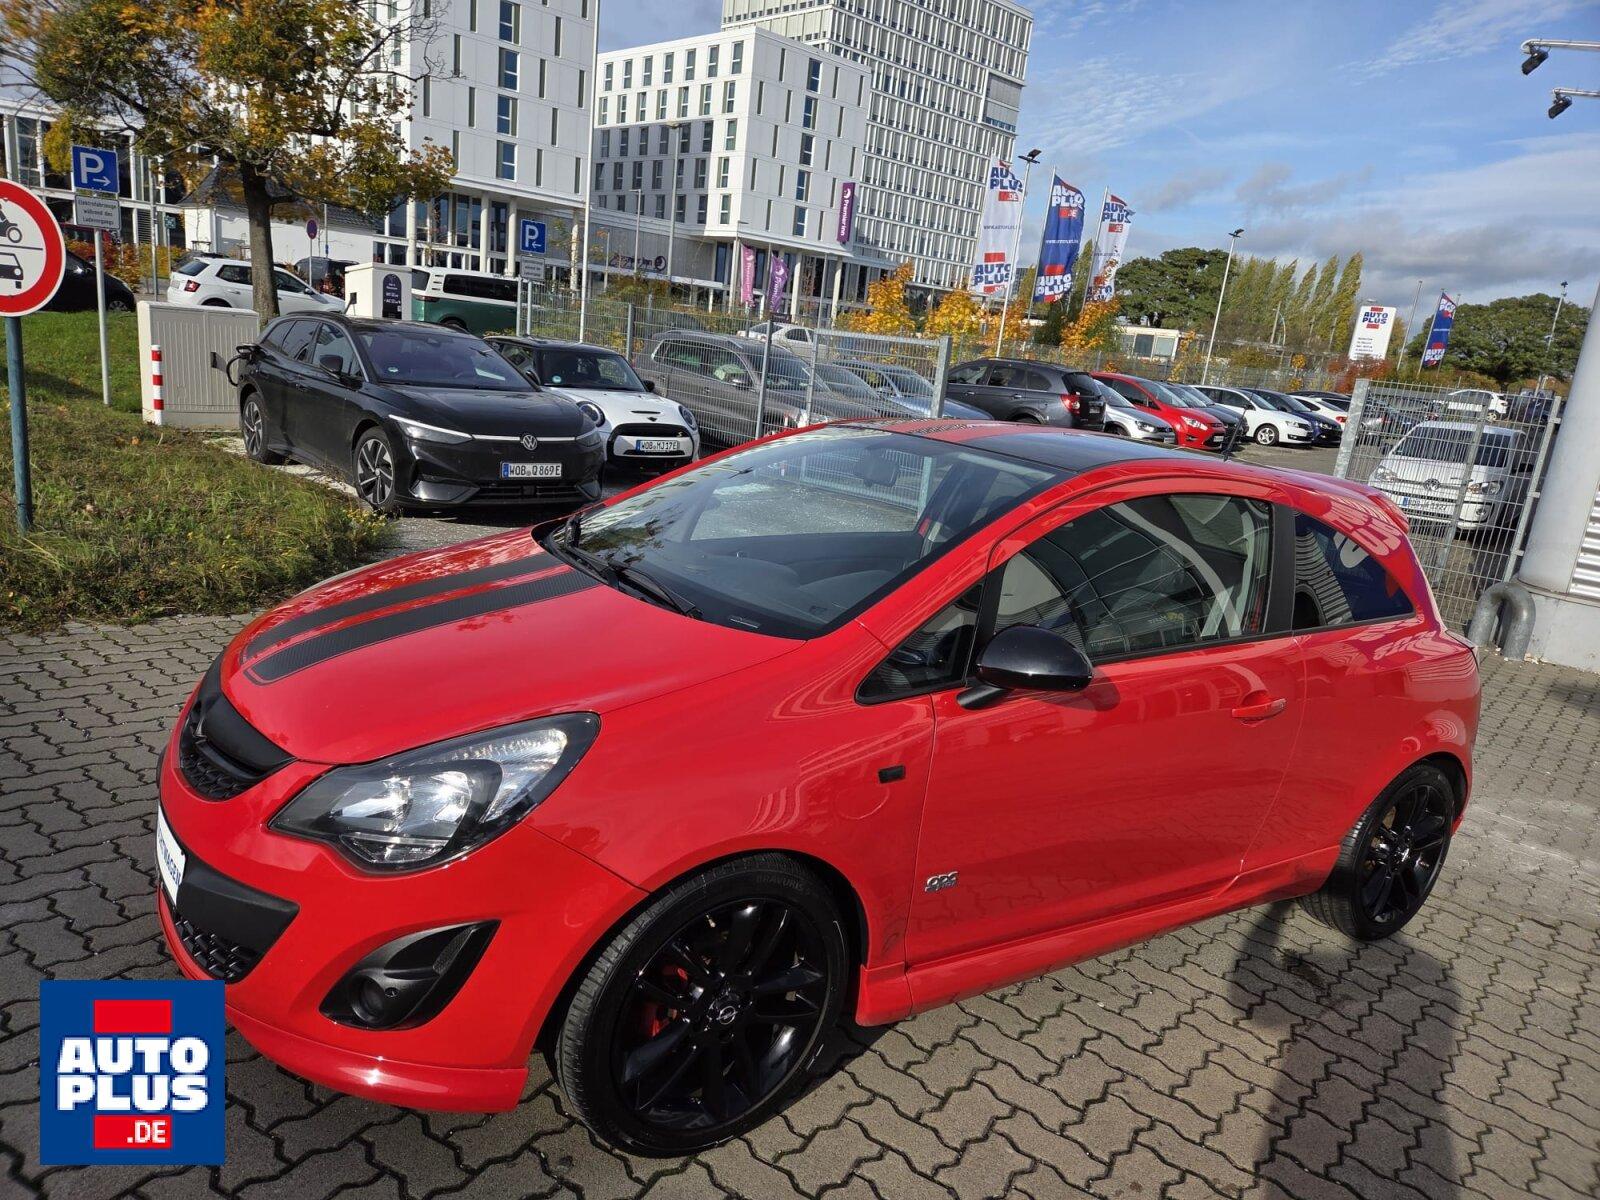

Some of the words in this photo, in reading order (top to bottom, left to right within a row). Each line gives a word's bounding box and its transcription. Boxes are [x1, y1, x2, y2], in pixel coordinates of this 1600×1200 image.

[80, 152, 104, 184] P
[525, 225, 539, 247] P
[1037, 274, 1071, 286] AUTO
[510, 465, 526, 476] WOB
